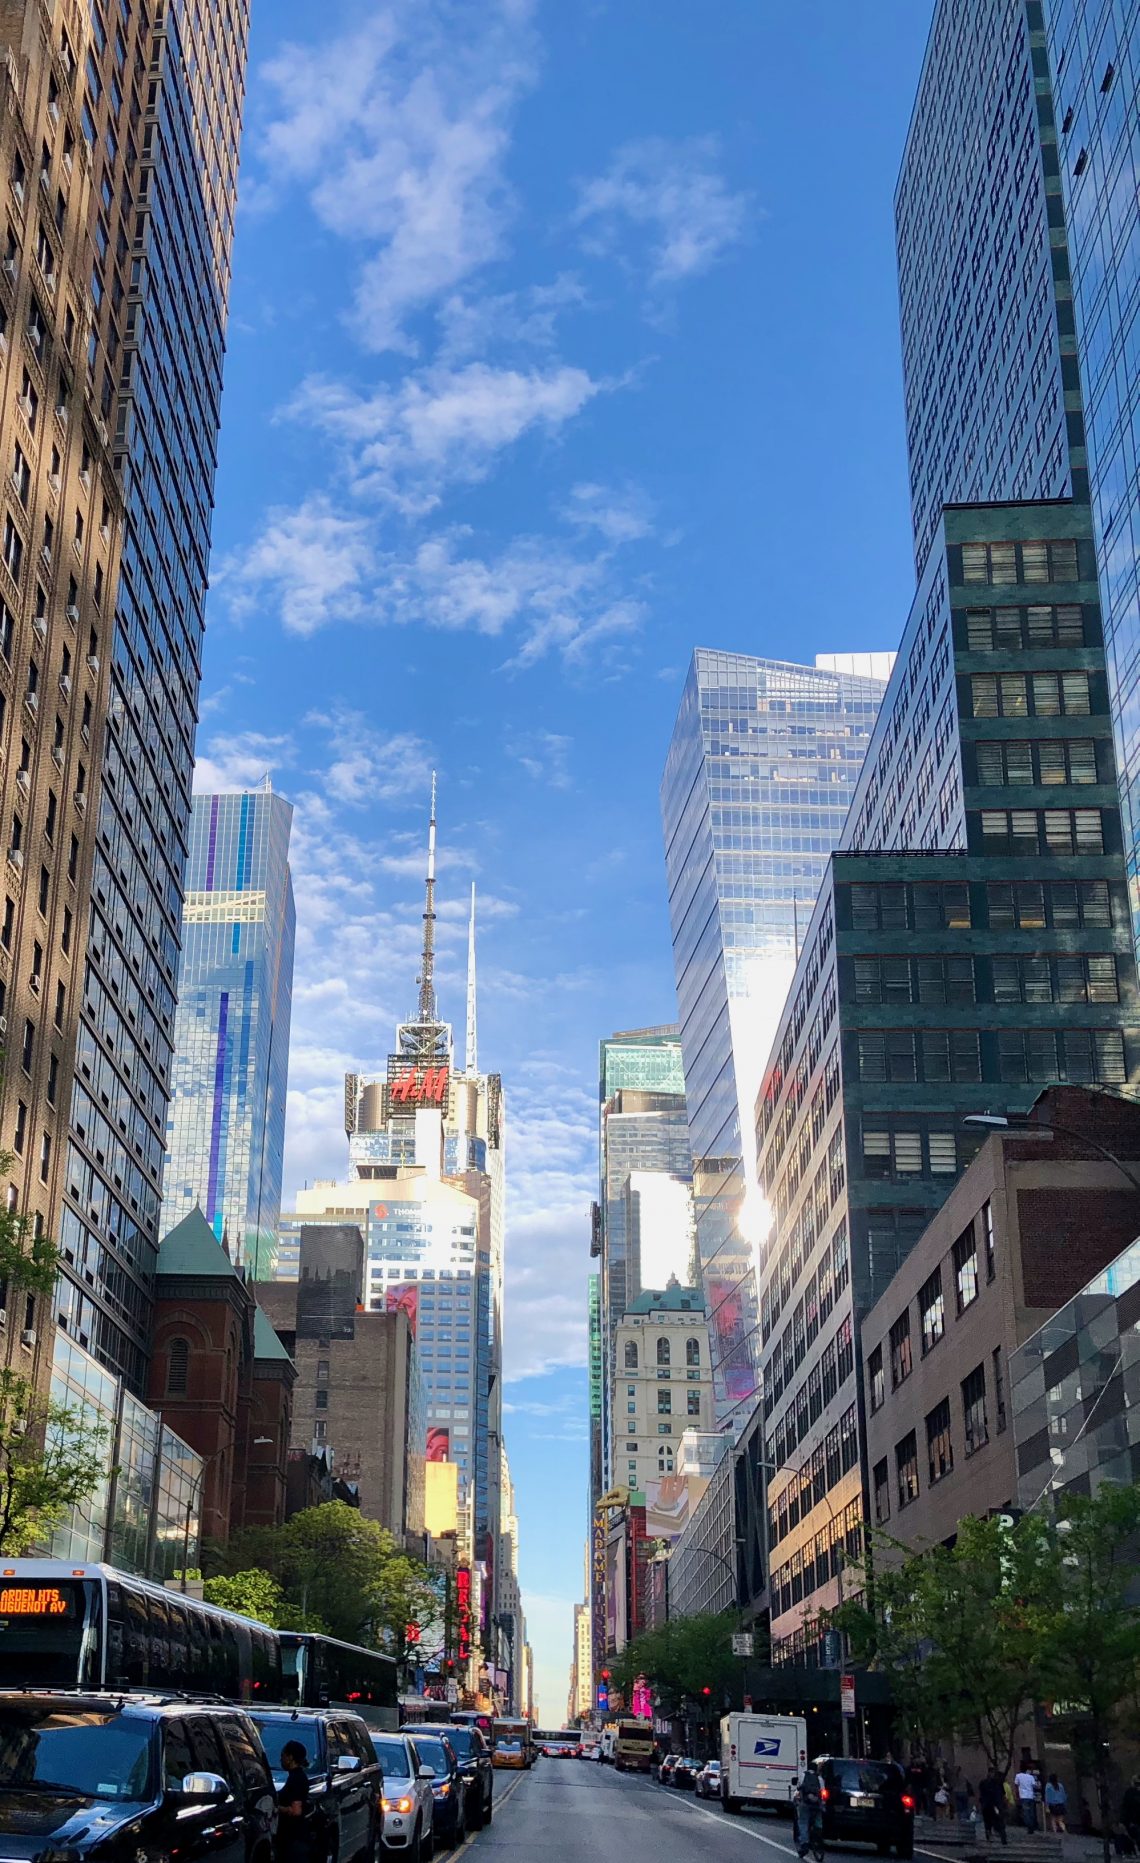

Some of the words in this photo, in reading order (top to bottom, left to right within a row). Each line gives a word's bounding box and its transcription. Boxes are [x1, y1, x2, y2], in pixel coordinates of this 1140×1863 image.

[391, 1066, 448, 1102] H&M
[593, 1518, 604, 1582] MADAME
[0, 1601, 47, 1613] UGUENOT
[50, 1601, 66, 1613] AV
[1, 1589, 35, 1602] ARDEN
[38, 1589, 59, 1602] HTS
